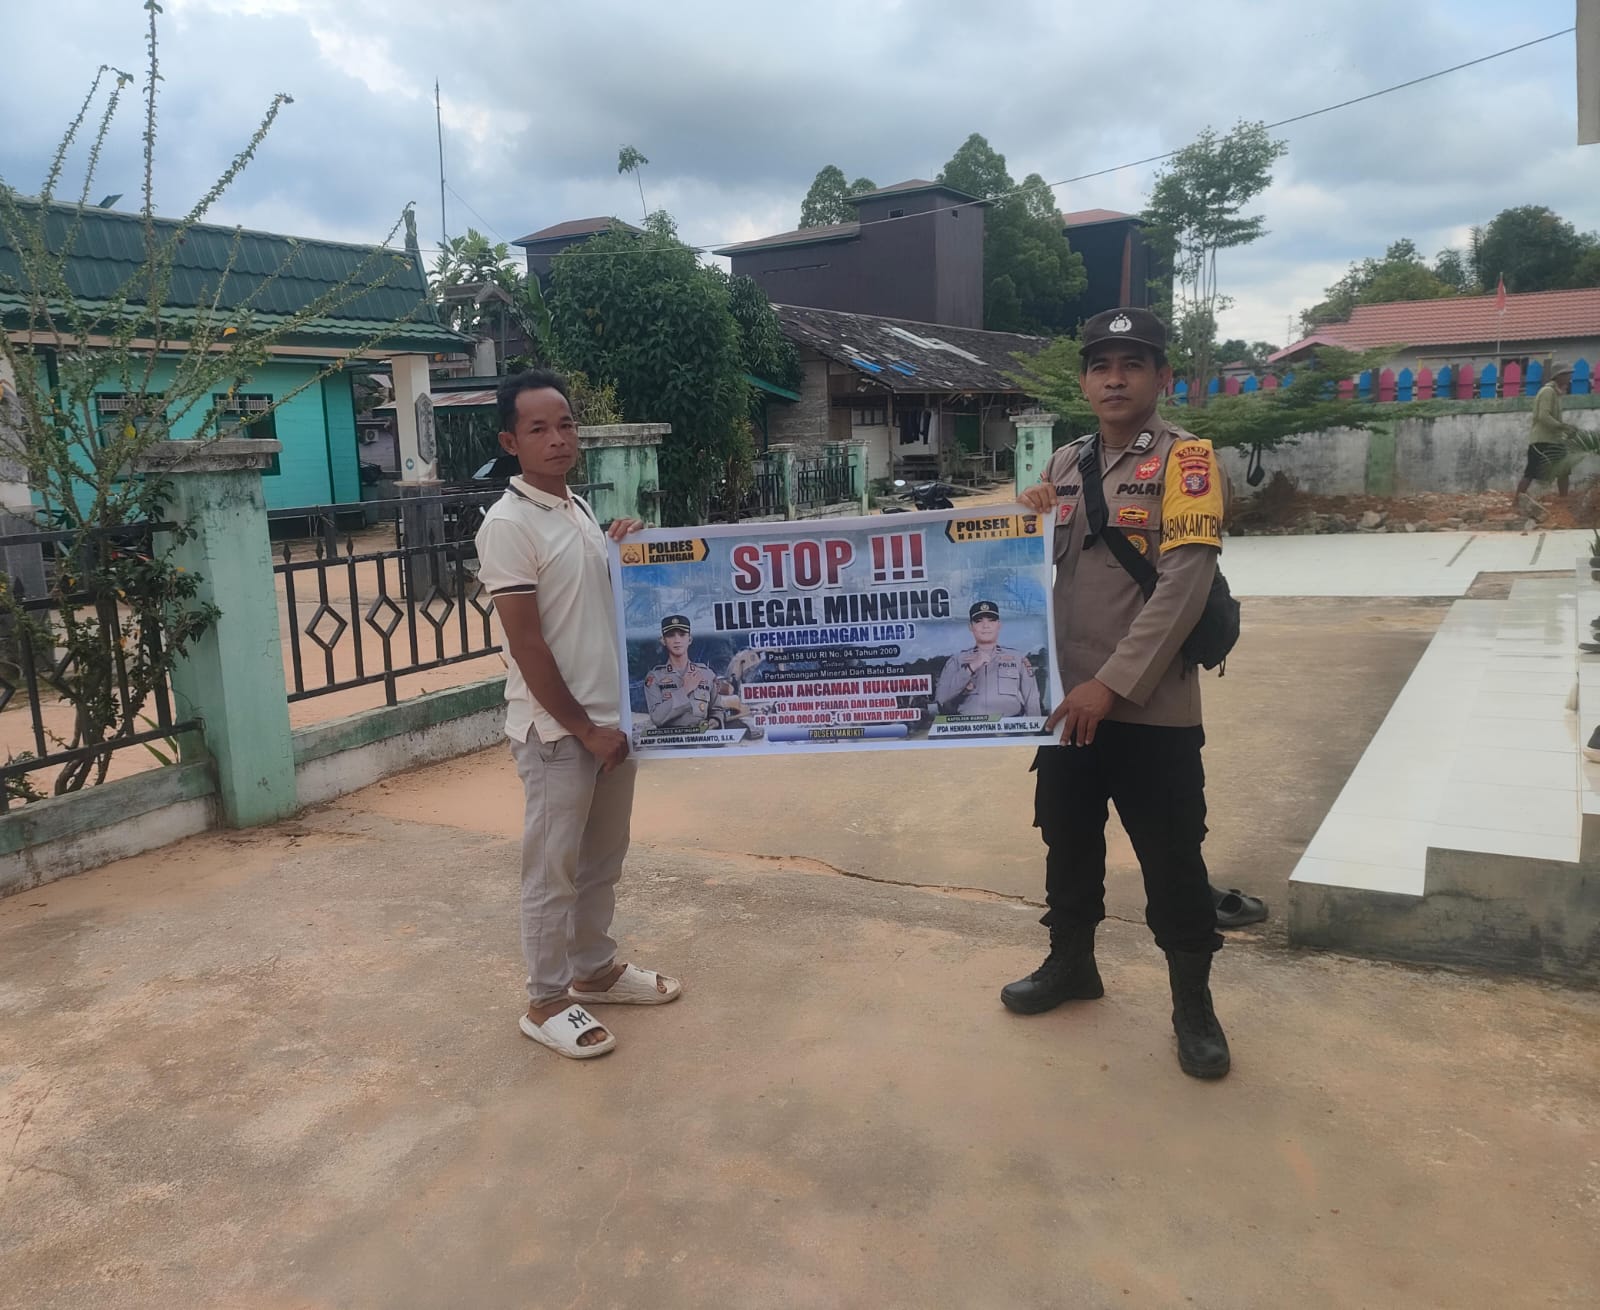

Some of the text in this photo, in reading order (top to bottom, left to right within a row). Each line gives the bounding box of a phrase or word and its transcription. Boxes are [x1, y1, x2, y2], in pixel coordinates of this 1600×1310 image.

[1117, 482, 1163, 496] POLRI
[956, 517, 1010, 532] POLSEK
[648, 540, 693, 554] POLRES
[649, 552, 694, 564] KATINGAN
[733, 533, 925, 591] STOP !!!
[714, 588, 950, 630] ILLEGAL MINNING
[806, 651, 817, 659] UU
[829, 650, 842, 658] No.
[855, 649, 878, 657] Tahun
[879, 647, 898, 655] 2009
[764, 666, 904, 680] Pertambangan Mineral Dan Batu Bara
[743, 678, 929, 699] DENGAN ANCAMAN HUKUMAN
[777, 697, 896, 712] 10 TAHUN PENJARA DAN DENDA
[853, 711, 882, 721] MILYAR
